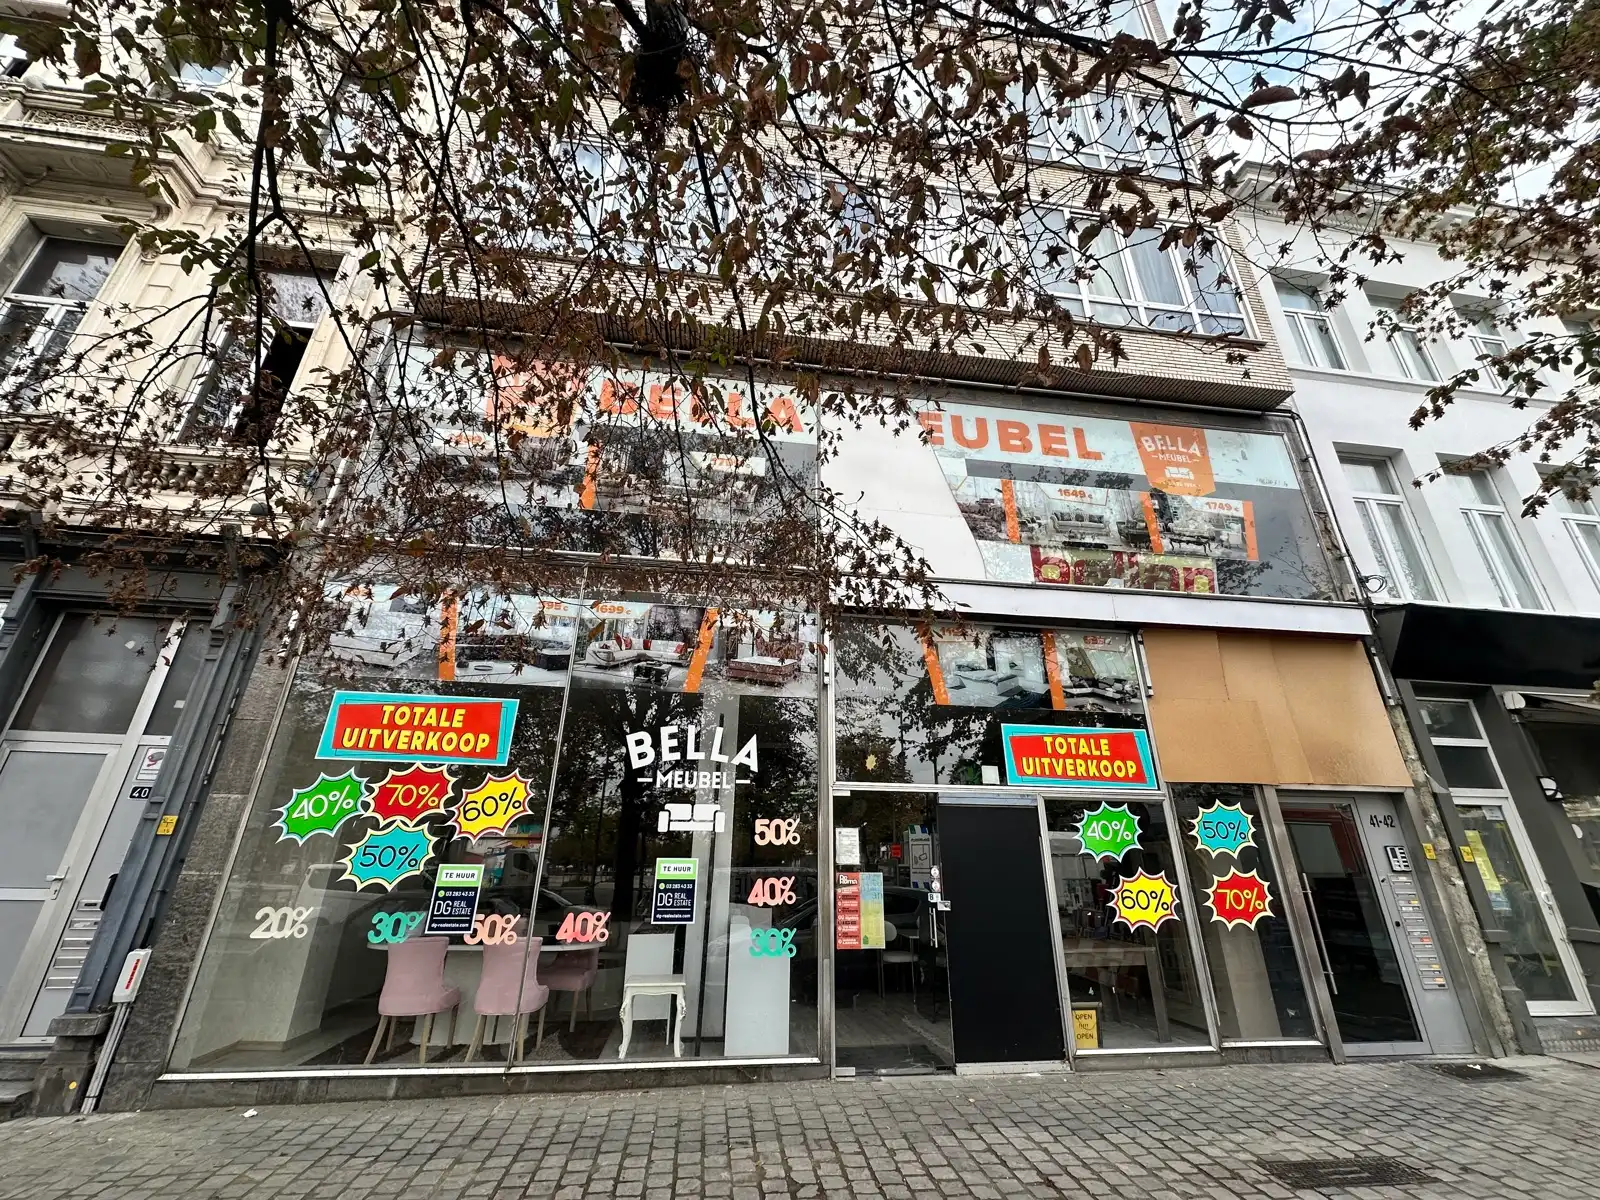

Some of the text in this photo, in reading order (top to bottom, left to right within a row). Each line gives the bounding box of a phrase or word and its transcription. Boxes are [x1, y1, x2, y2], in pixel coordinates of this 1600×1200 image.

[1141, 434, 1202, 457] BELLA
[1158, 453, 1193, 463] MEUBEL
[1057, 488, 1086, 498] 1649
[380, 705, 467, 727] TOTALE
[342, 727, 491, 753] UITVERKOOP
[626, 724, 759, 773] BELLA
[1043, 735, 1111, 757] TOTALE
[656, 770, 731, 789] MEUBEL
[1021, 756, 1137, 779] UITVERKOOP
[132, 788, 149, 798] 40
[291, 785, 354, 820] 40%
[385, 783, 439, 810] 70%
[462, 787, 522, 822] 60%
[754, 817, 801, 846] 50%
[1086, 818, 1132, 842] 40%
[1202, 820, 1246, 842] 50%
[1369, 814, 1396, 828] 41-42
[358, 845, 418, 869] 50%
[657, 892, 673, 906] DG
[747, 875, 797, 907] 40%
[1120, 888, 1169, 913] 60%
[1217, 887, 1264, 913] 70%
[433, 900, 467, 915] DG REAL
[452, 907, 472, 915] ESTATE
[249, 906, 314, 939] 20%
[463, 913, 521, 945] 50%
[555, 911, 612, 944] 40%
[749, 927, 797, 958] 30%
